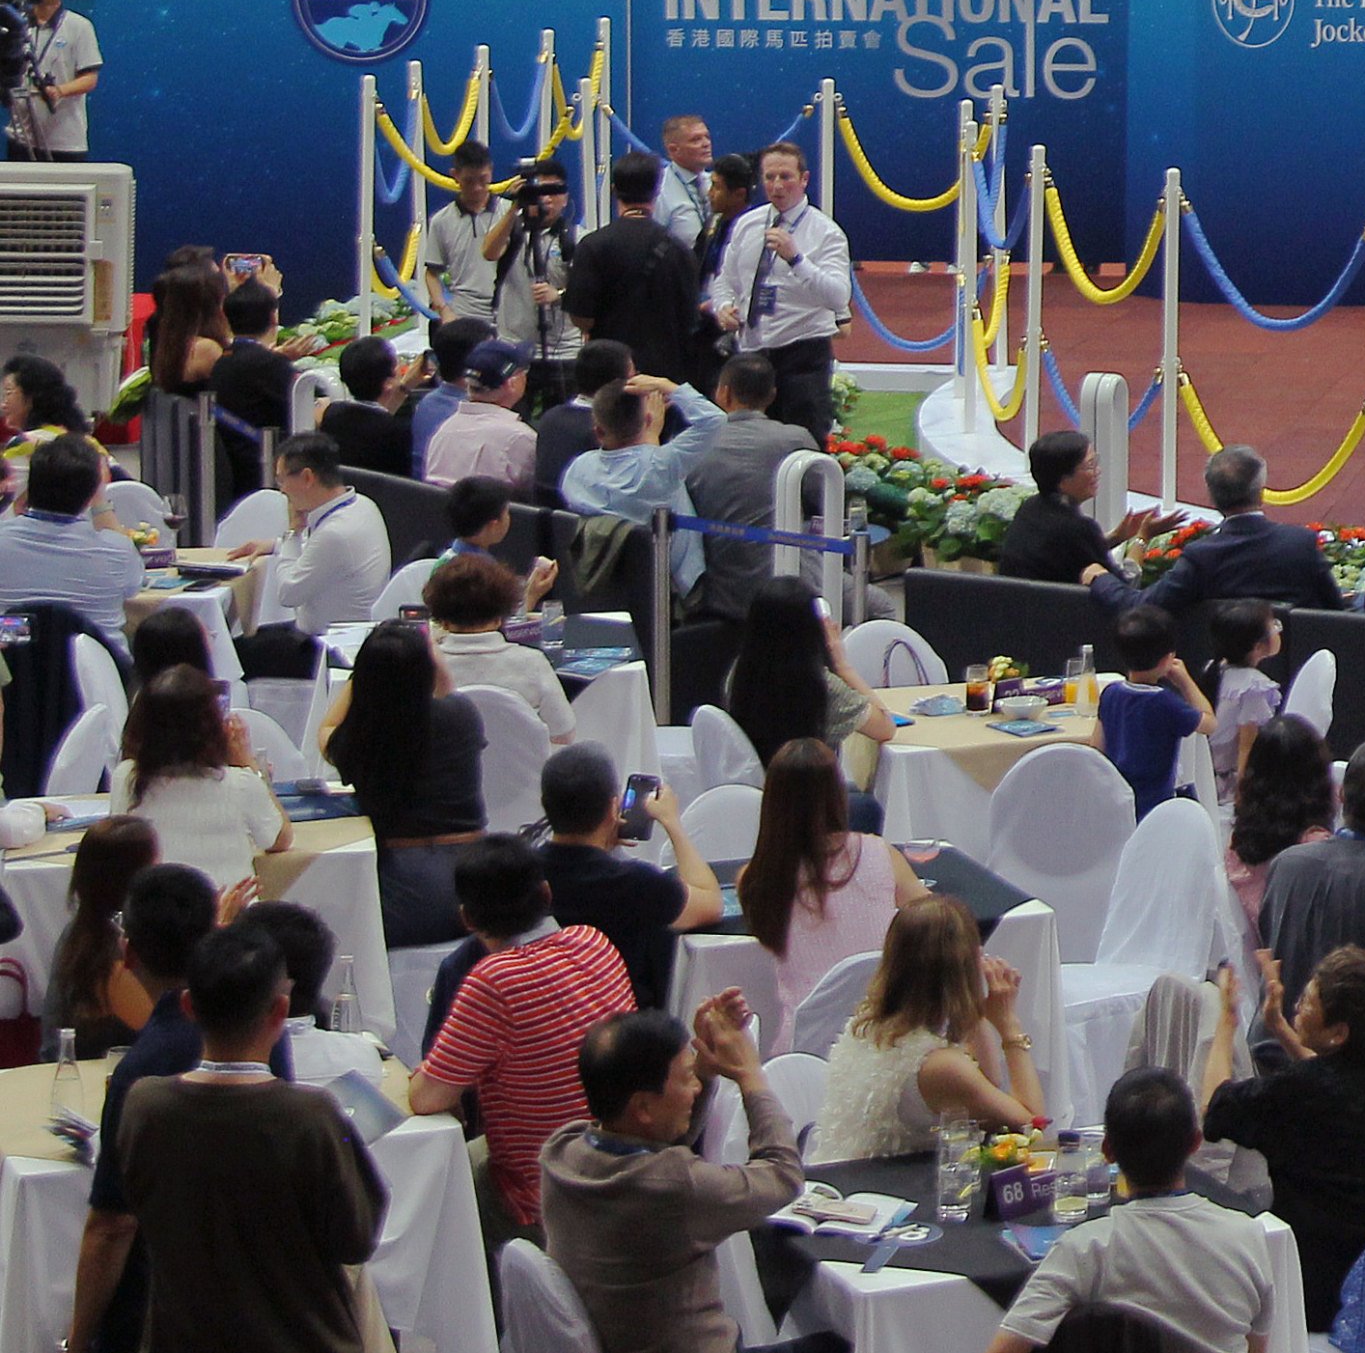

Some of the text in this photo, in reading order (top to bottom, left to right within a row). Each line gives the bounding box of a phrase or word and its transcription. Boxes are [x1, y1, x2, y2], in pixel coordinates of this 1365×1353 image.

[666, 27, 882, 49] 香港國際馬匹拍賣會
[893, 14, 1097, 99] Sale
[1002, 1182, 1024, 1204] 68
